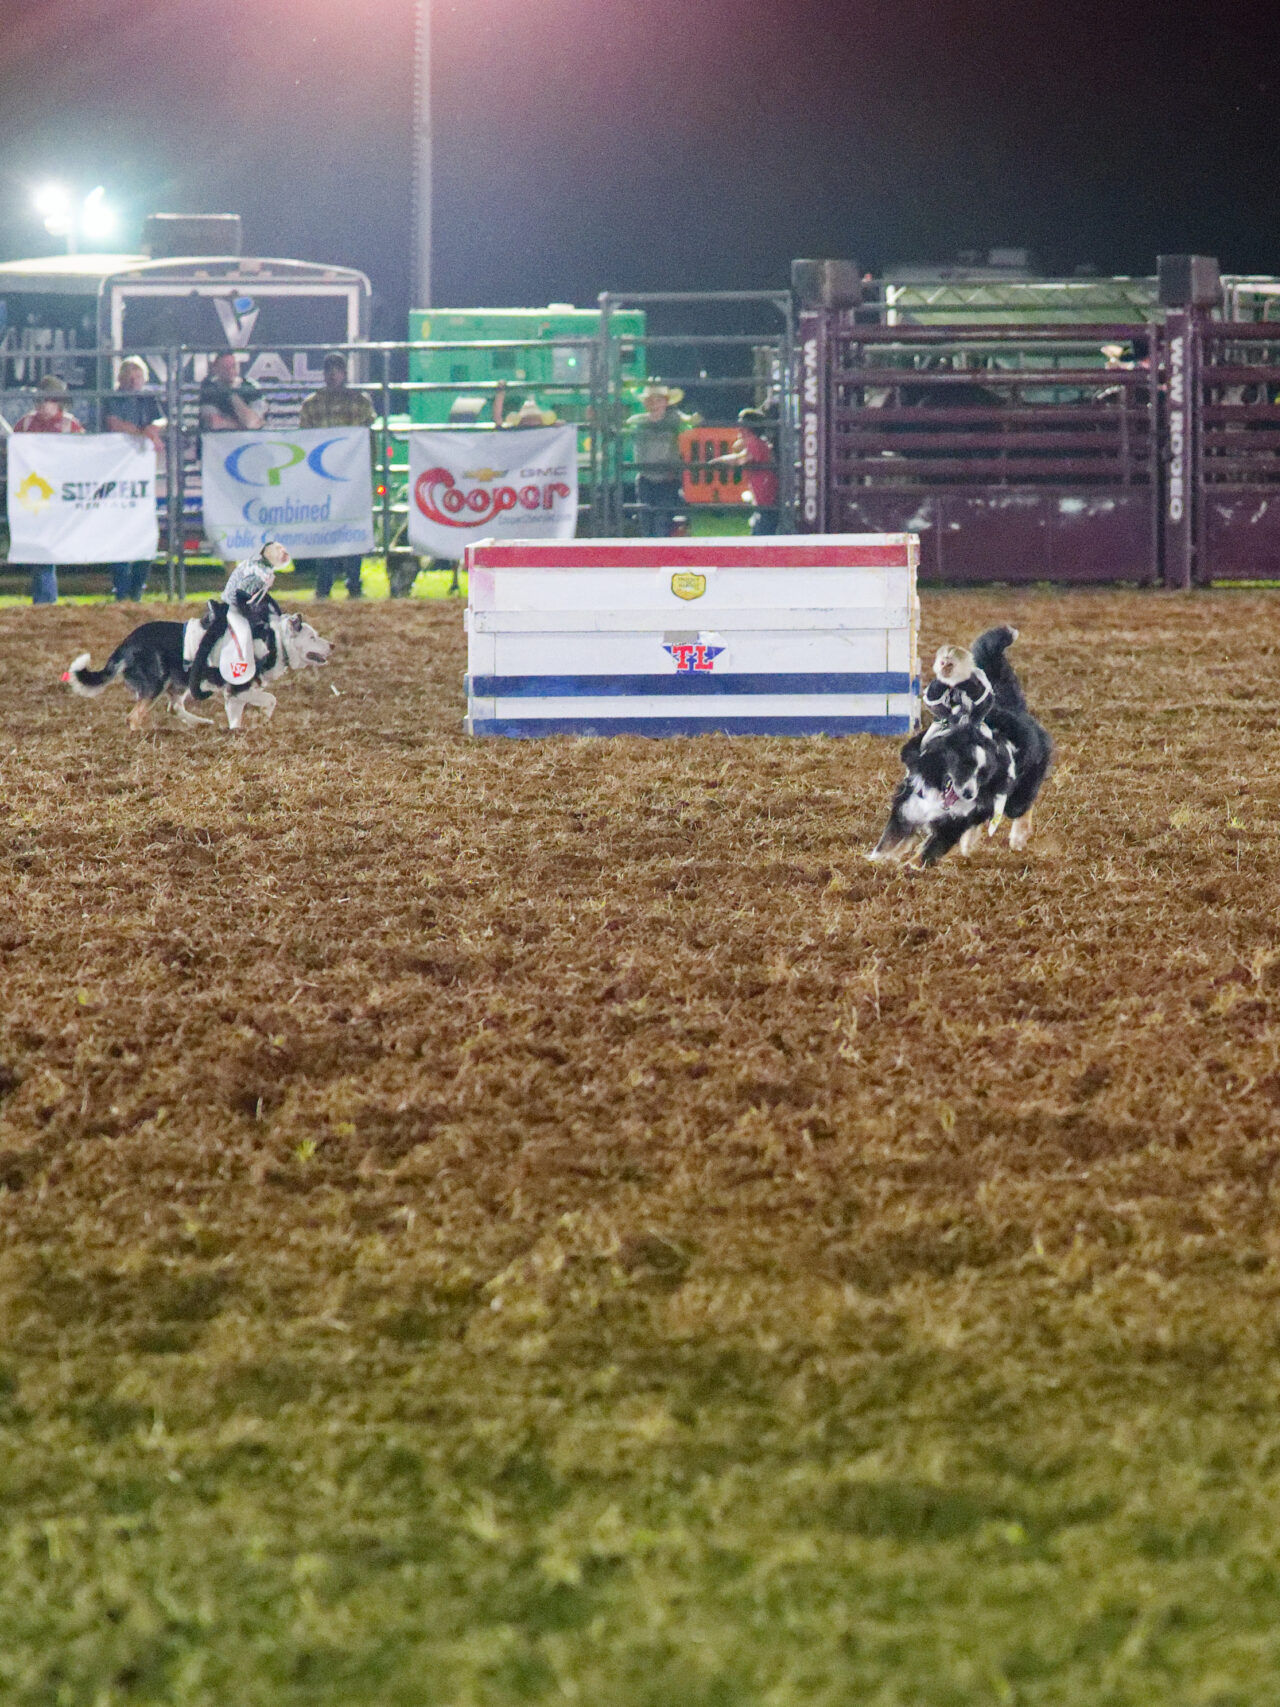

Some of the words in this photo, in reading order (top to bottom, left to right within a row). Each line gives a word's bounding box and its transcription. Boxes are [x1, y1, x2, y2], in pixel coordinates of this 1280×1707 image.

[146, 351, 325, 382] VITAL
[803, 412, 818, 521] RODEO
[1169, 410, 1184, 521] RODEO
[242, 494, 332, 524] Combined
[414, 467, 571, 528] Cooper
[672, 645, 714, 670] TL
